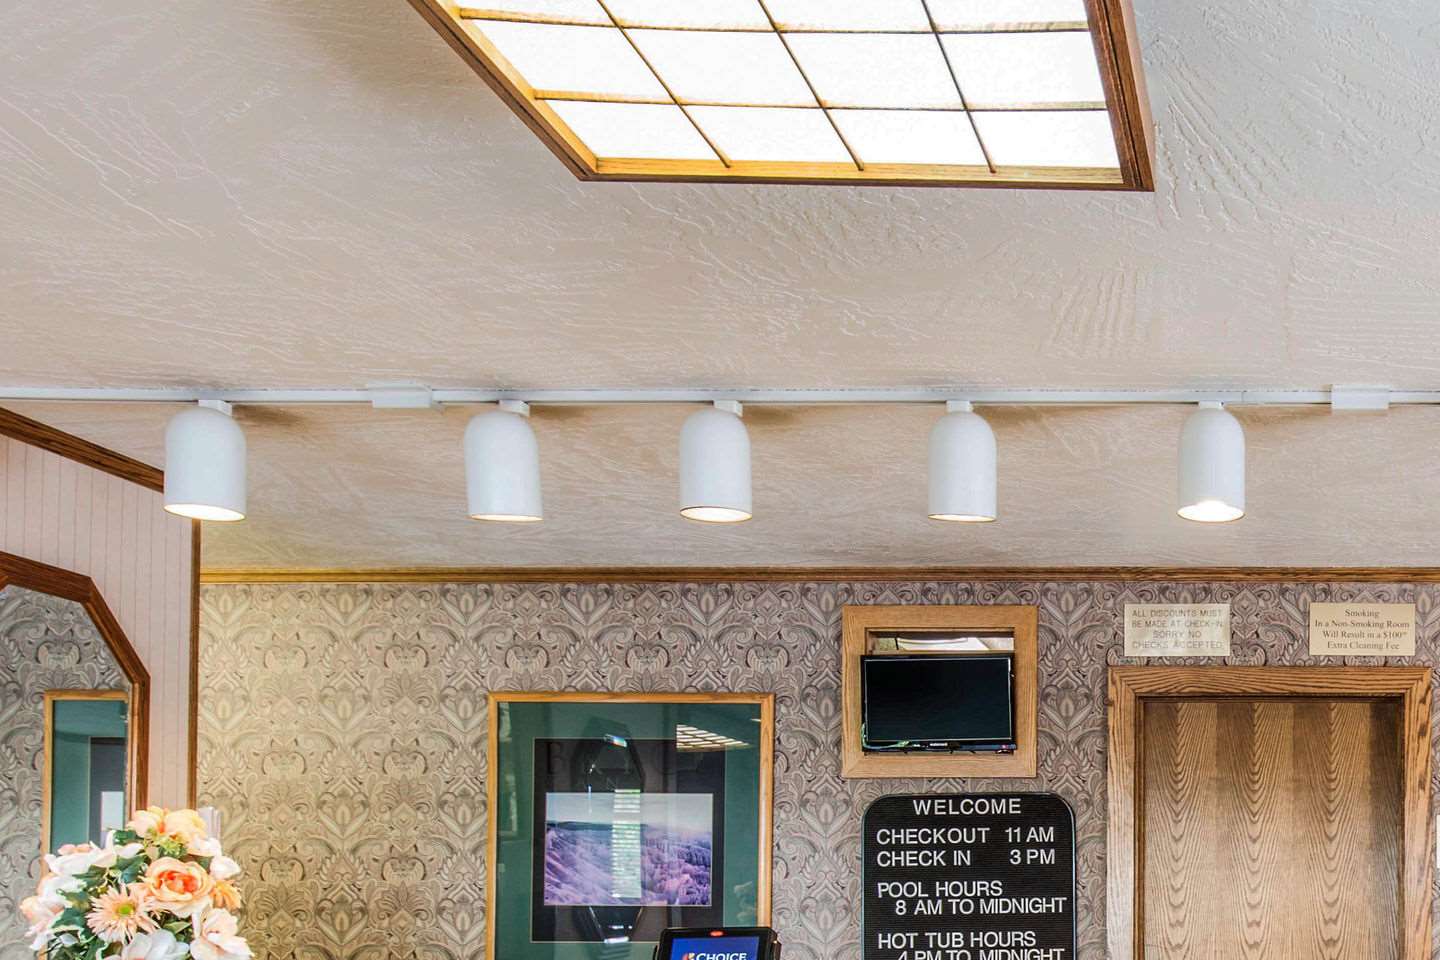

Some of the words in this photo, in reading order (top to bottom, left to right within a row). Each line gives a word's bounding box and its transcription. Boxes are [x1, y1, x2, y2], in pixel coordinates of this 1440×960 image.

[1345, 609, 1380, 618] Smoking
[1386, 620, 1410, 628] Room
[1322, 630, 1339, 638] Will
[1341, 630, 1365, 638] Result
[1327, 641, 1348, 649] Extra
[1349, 641, 1384, 650] Cleaning
[1386, 641, 1400, 649] Fee
[913, 799, 1022, 815] WELCOME
[876, 828, 990, 845] CHECKOUT
[1005, 828, 1021, 843] 11
[1026, 827, 1054, 843] AM
[877, 850, 946, 867] CHECK
[954, 850, 971, 866] IN
[1010, 850, 1021, 865] 3
[1026, 849, 1055, 865] PM
[877, 882, 929, 898] POOL
[936, 880, 1003, 897] HOURS
[895, 900, 906, 916] 8
[914, 899, 943, 915] AM
[948, 899, 974, 915] TO
[980, 897, 1067, 915] MIDNIGHT
[878, 933, 918, 950] HOT
[925, 932, 964, 949] TUB
[970, 931, 1036, 948] HOURS
